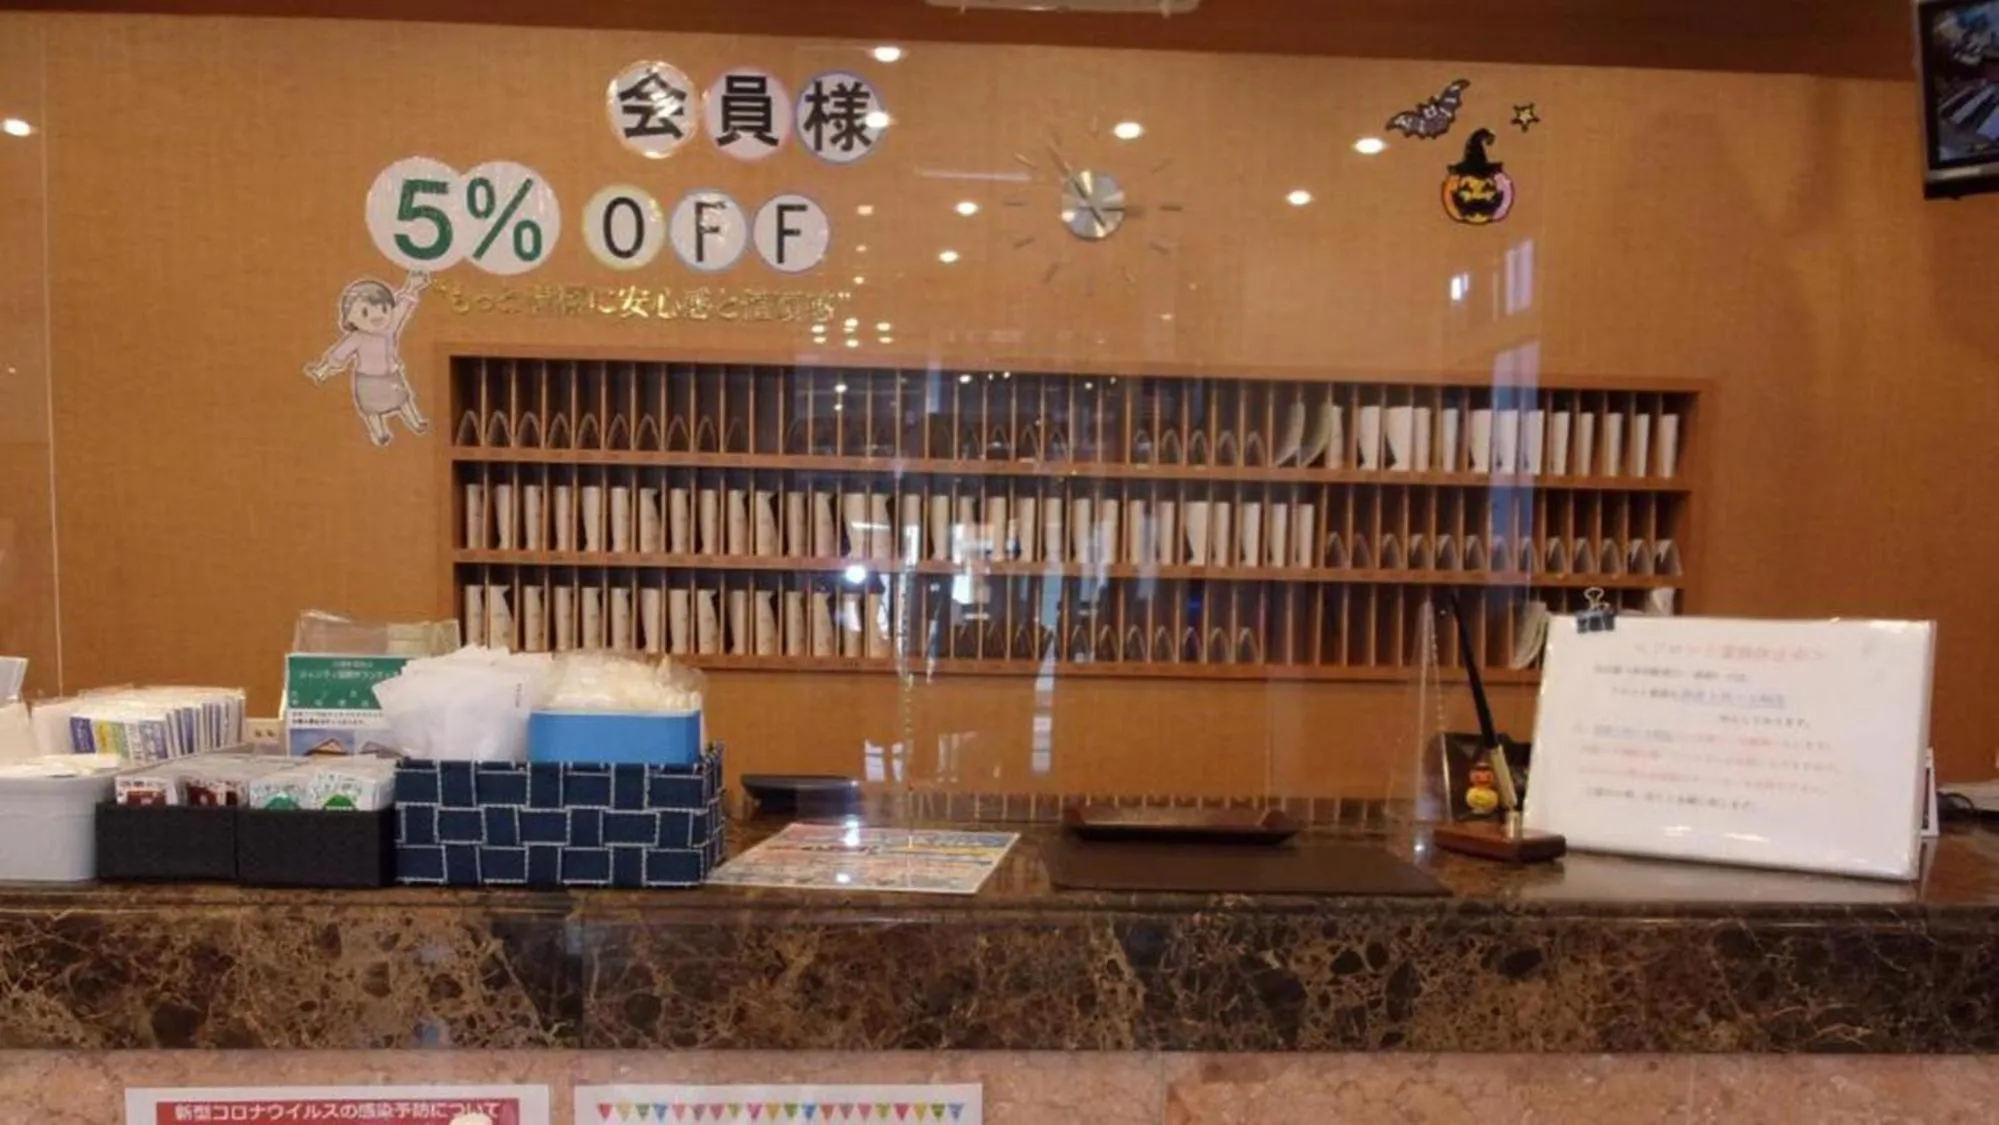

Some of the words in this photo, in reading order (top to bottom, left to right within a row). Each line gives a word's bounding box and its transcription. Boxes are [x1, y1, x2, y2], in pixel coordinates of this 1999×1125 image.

[617, 71, 875, 153] 会員様
[393, 177, 543, 263] 5%
[602, 196, 808, 265] OFF
[175, 1103, 499, 1120] 新型コロナウイルスの感染予防について
